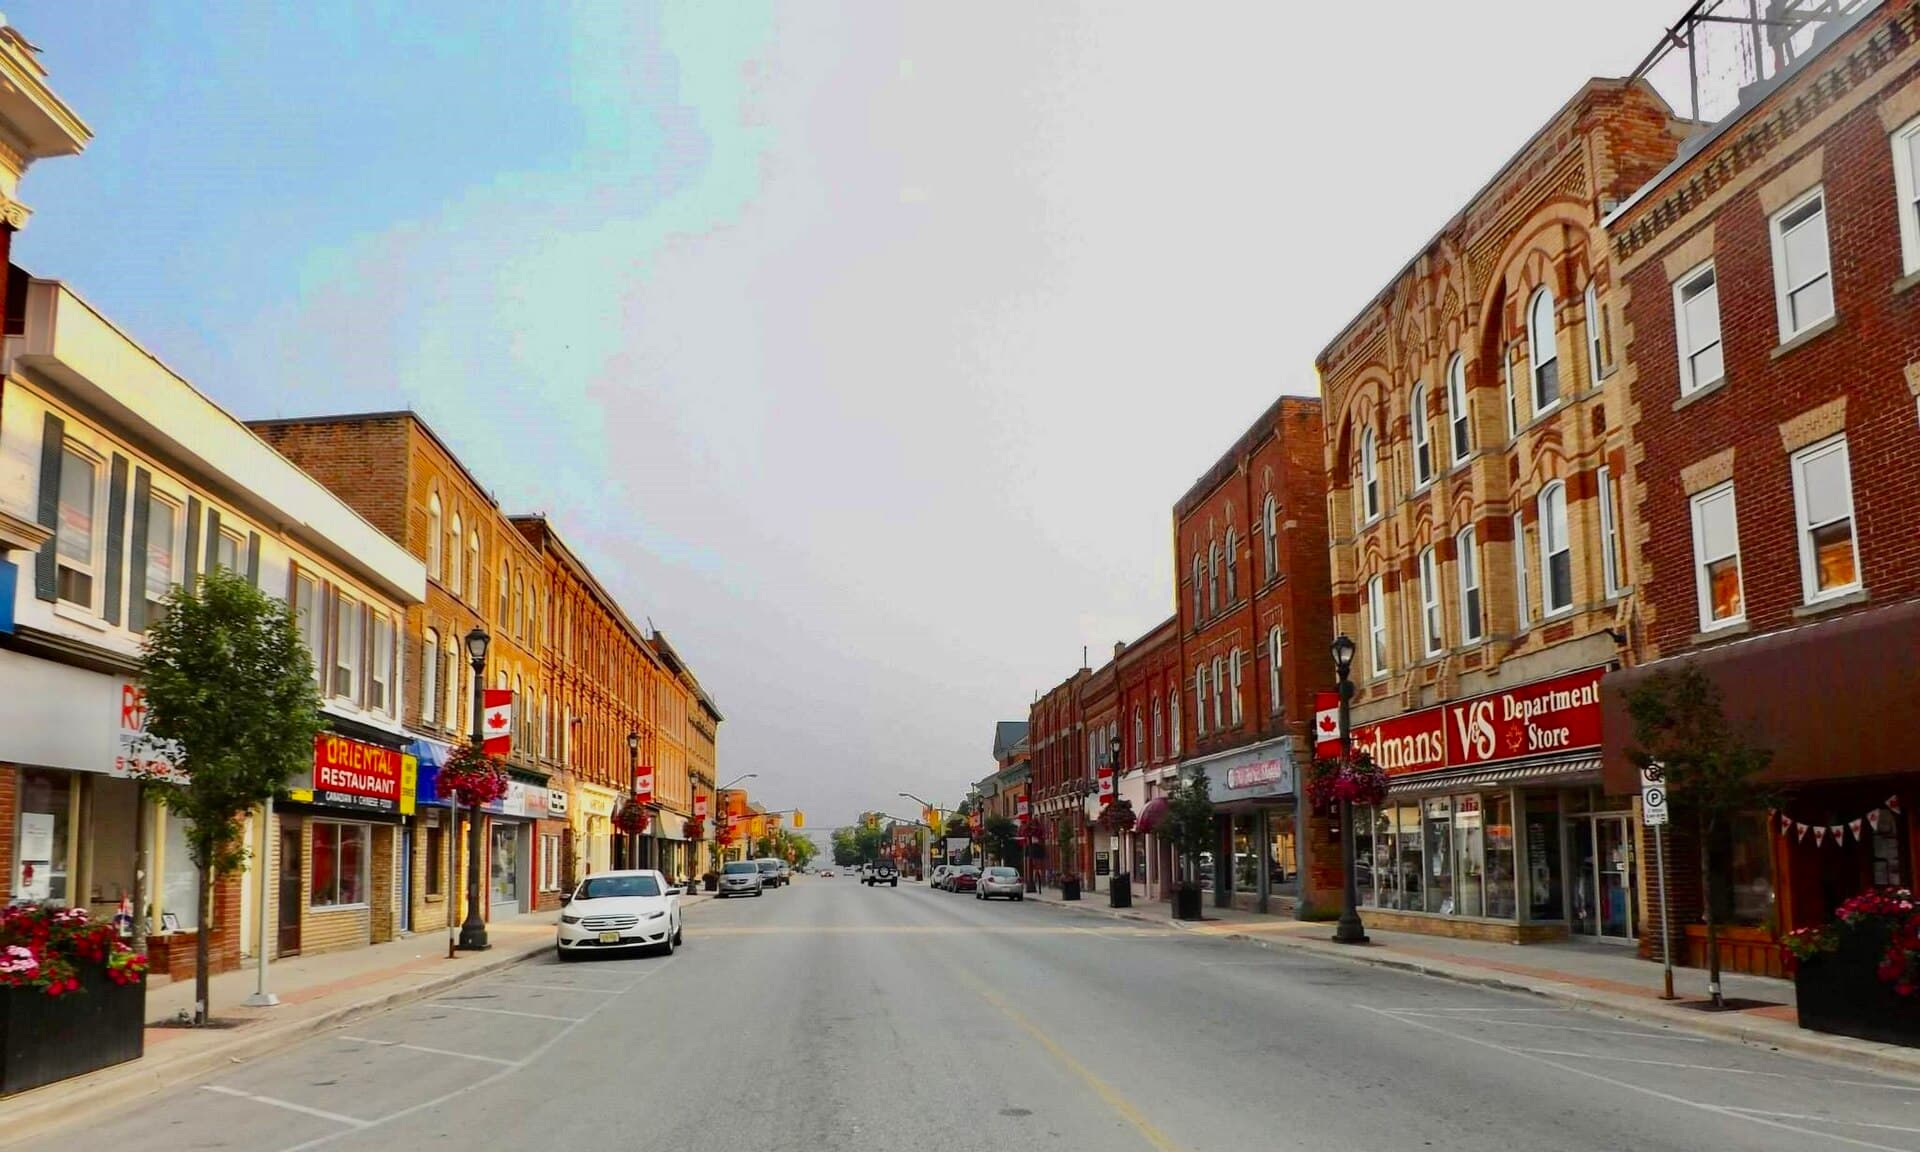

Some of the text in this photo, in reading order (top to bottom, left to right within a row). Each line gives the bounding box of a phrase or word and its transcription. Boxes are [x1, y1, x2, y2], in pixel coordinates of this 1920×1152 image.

[1502, 680, 1599, 726] Department
[1349, 701, 1496, 770] dmans V&S
[1528, 723, 1570, 750] Store
[327, 738, 393, 775] ORIENTAL
[321, 767, 395, 794] RESTAURANT
